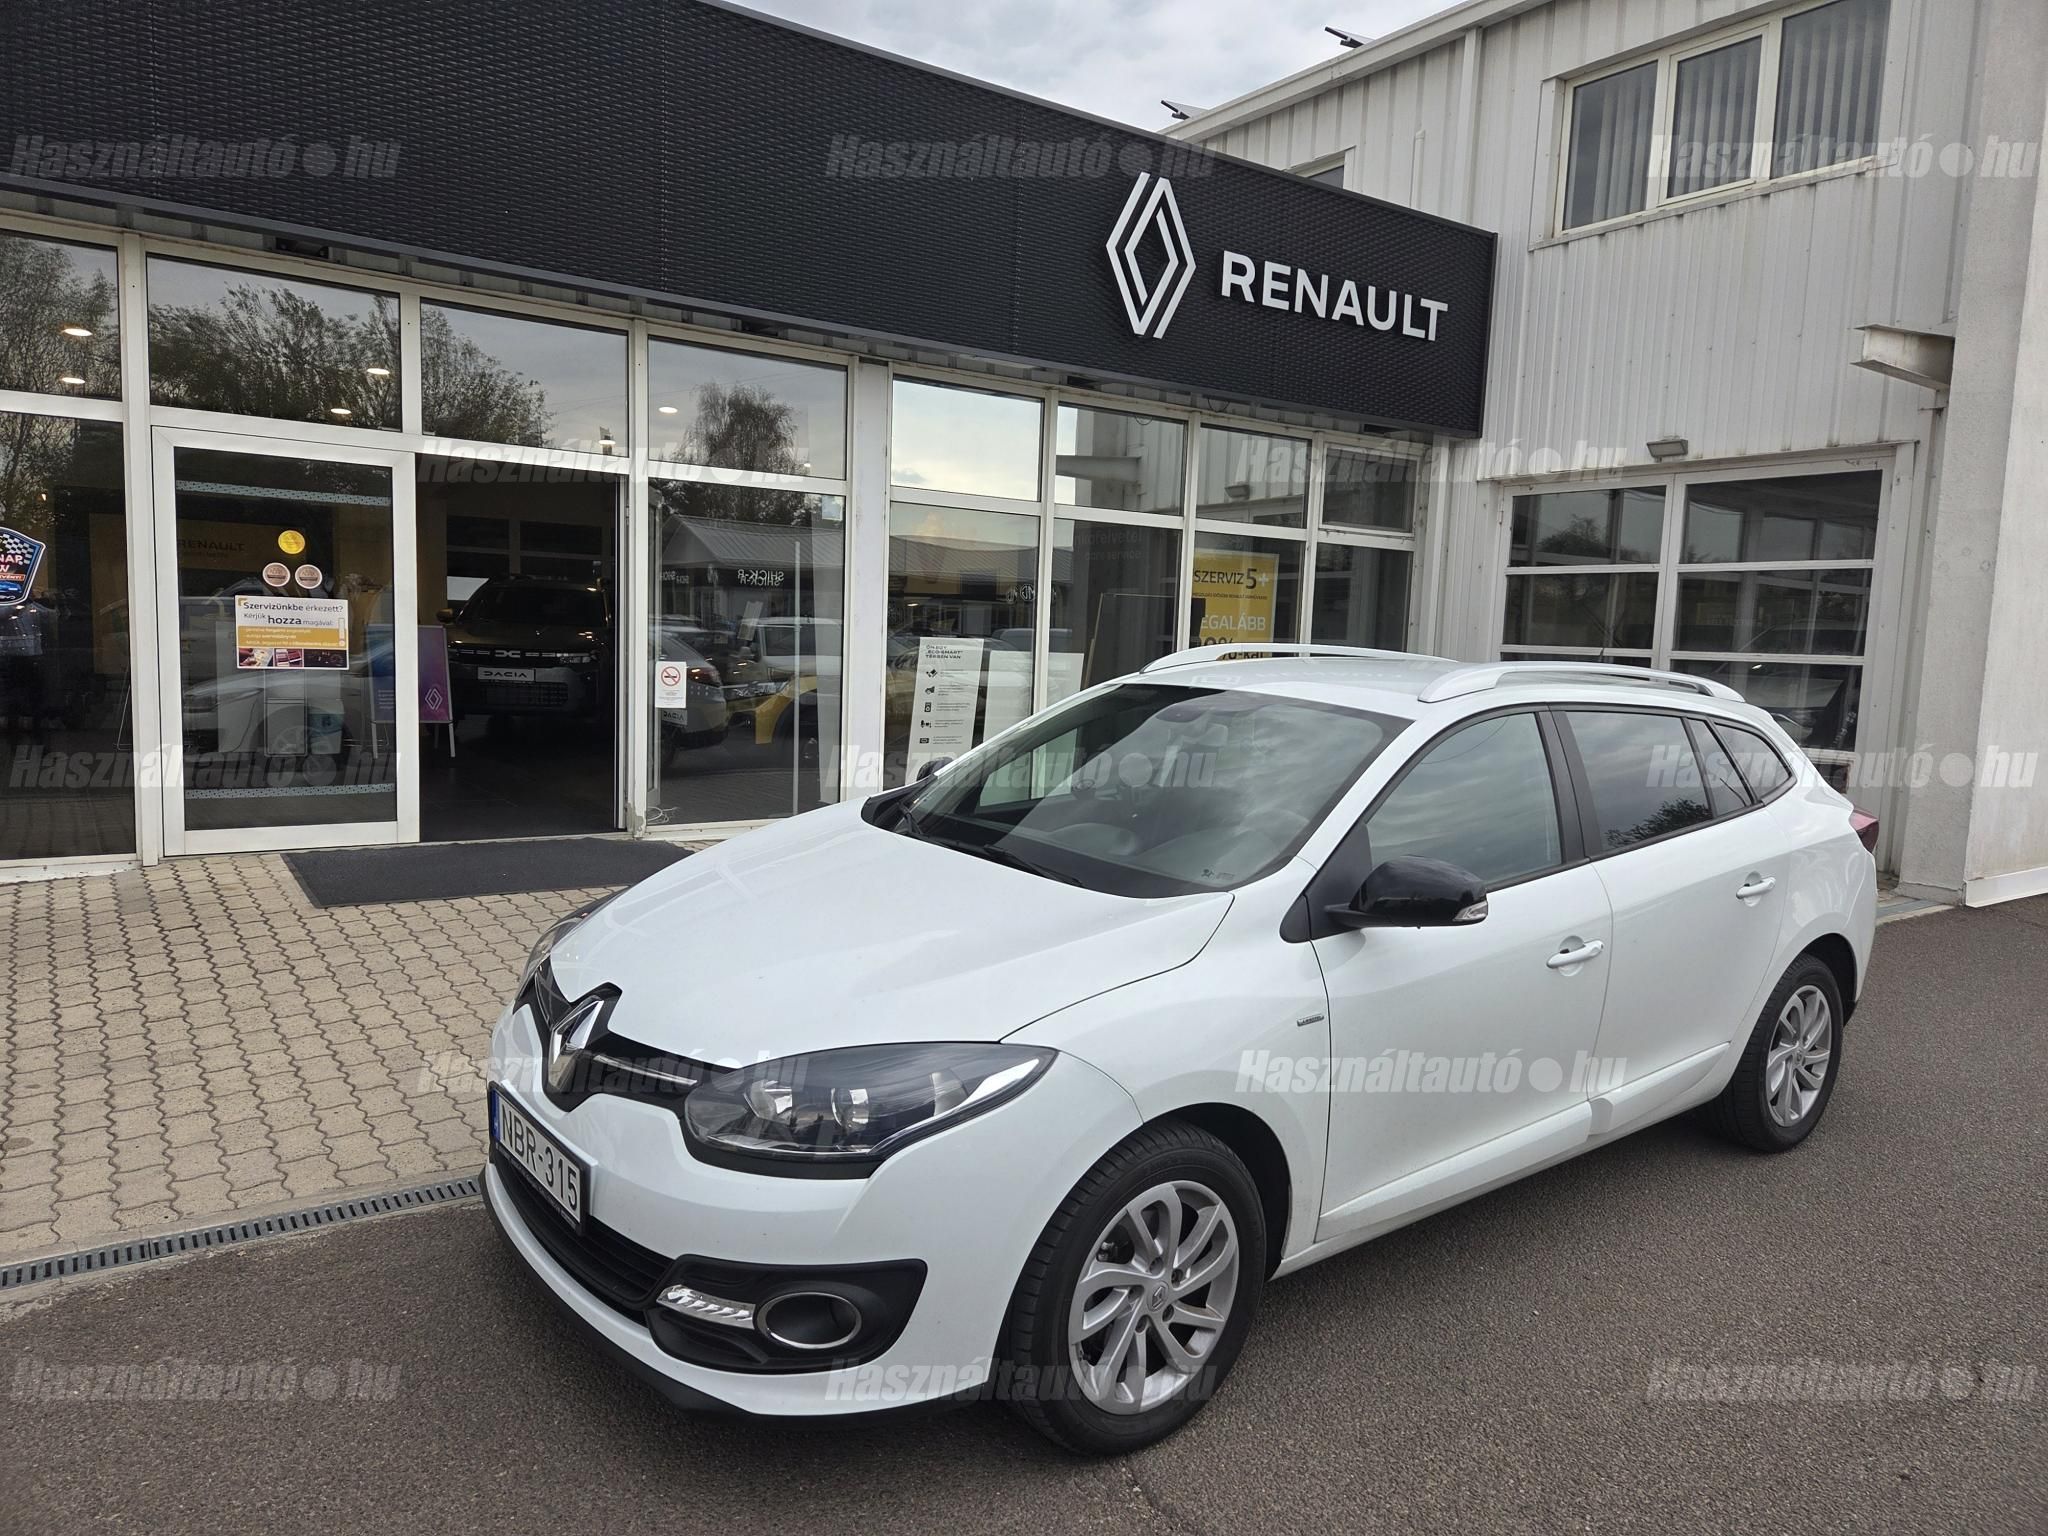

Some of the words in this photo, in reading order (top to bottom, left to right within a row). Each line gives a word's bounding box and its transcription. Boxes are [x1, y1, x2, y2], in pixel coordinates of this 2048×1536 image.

[1221, 250, 1449, 341] RENAULT
[1193, 570, 1245, 585] SZERVIZ
[243, 601, 304, 611] Szervizünkbe
[305, 604, 344, 612] érkezett?
[243, 612, 266, 620] Kérjük
[267, 614, 302, 625] hozza
[1200, 611, 1266, 631] EGALÁBB
[483, 670, 527, 678] DACIA
[502, 1103, 578, 1211] NBR-315
